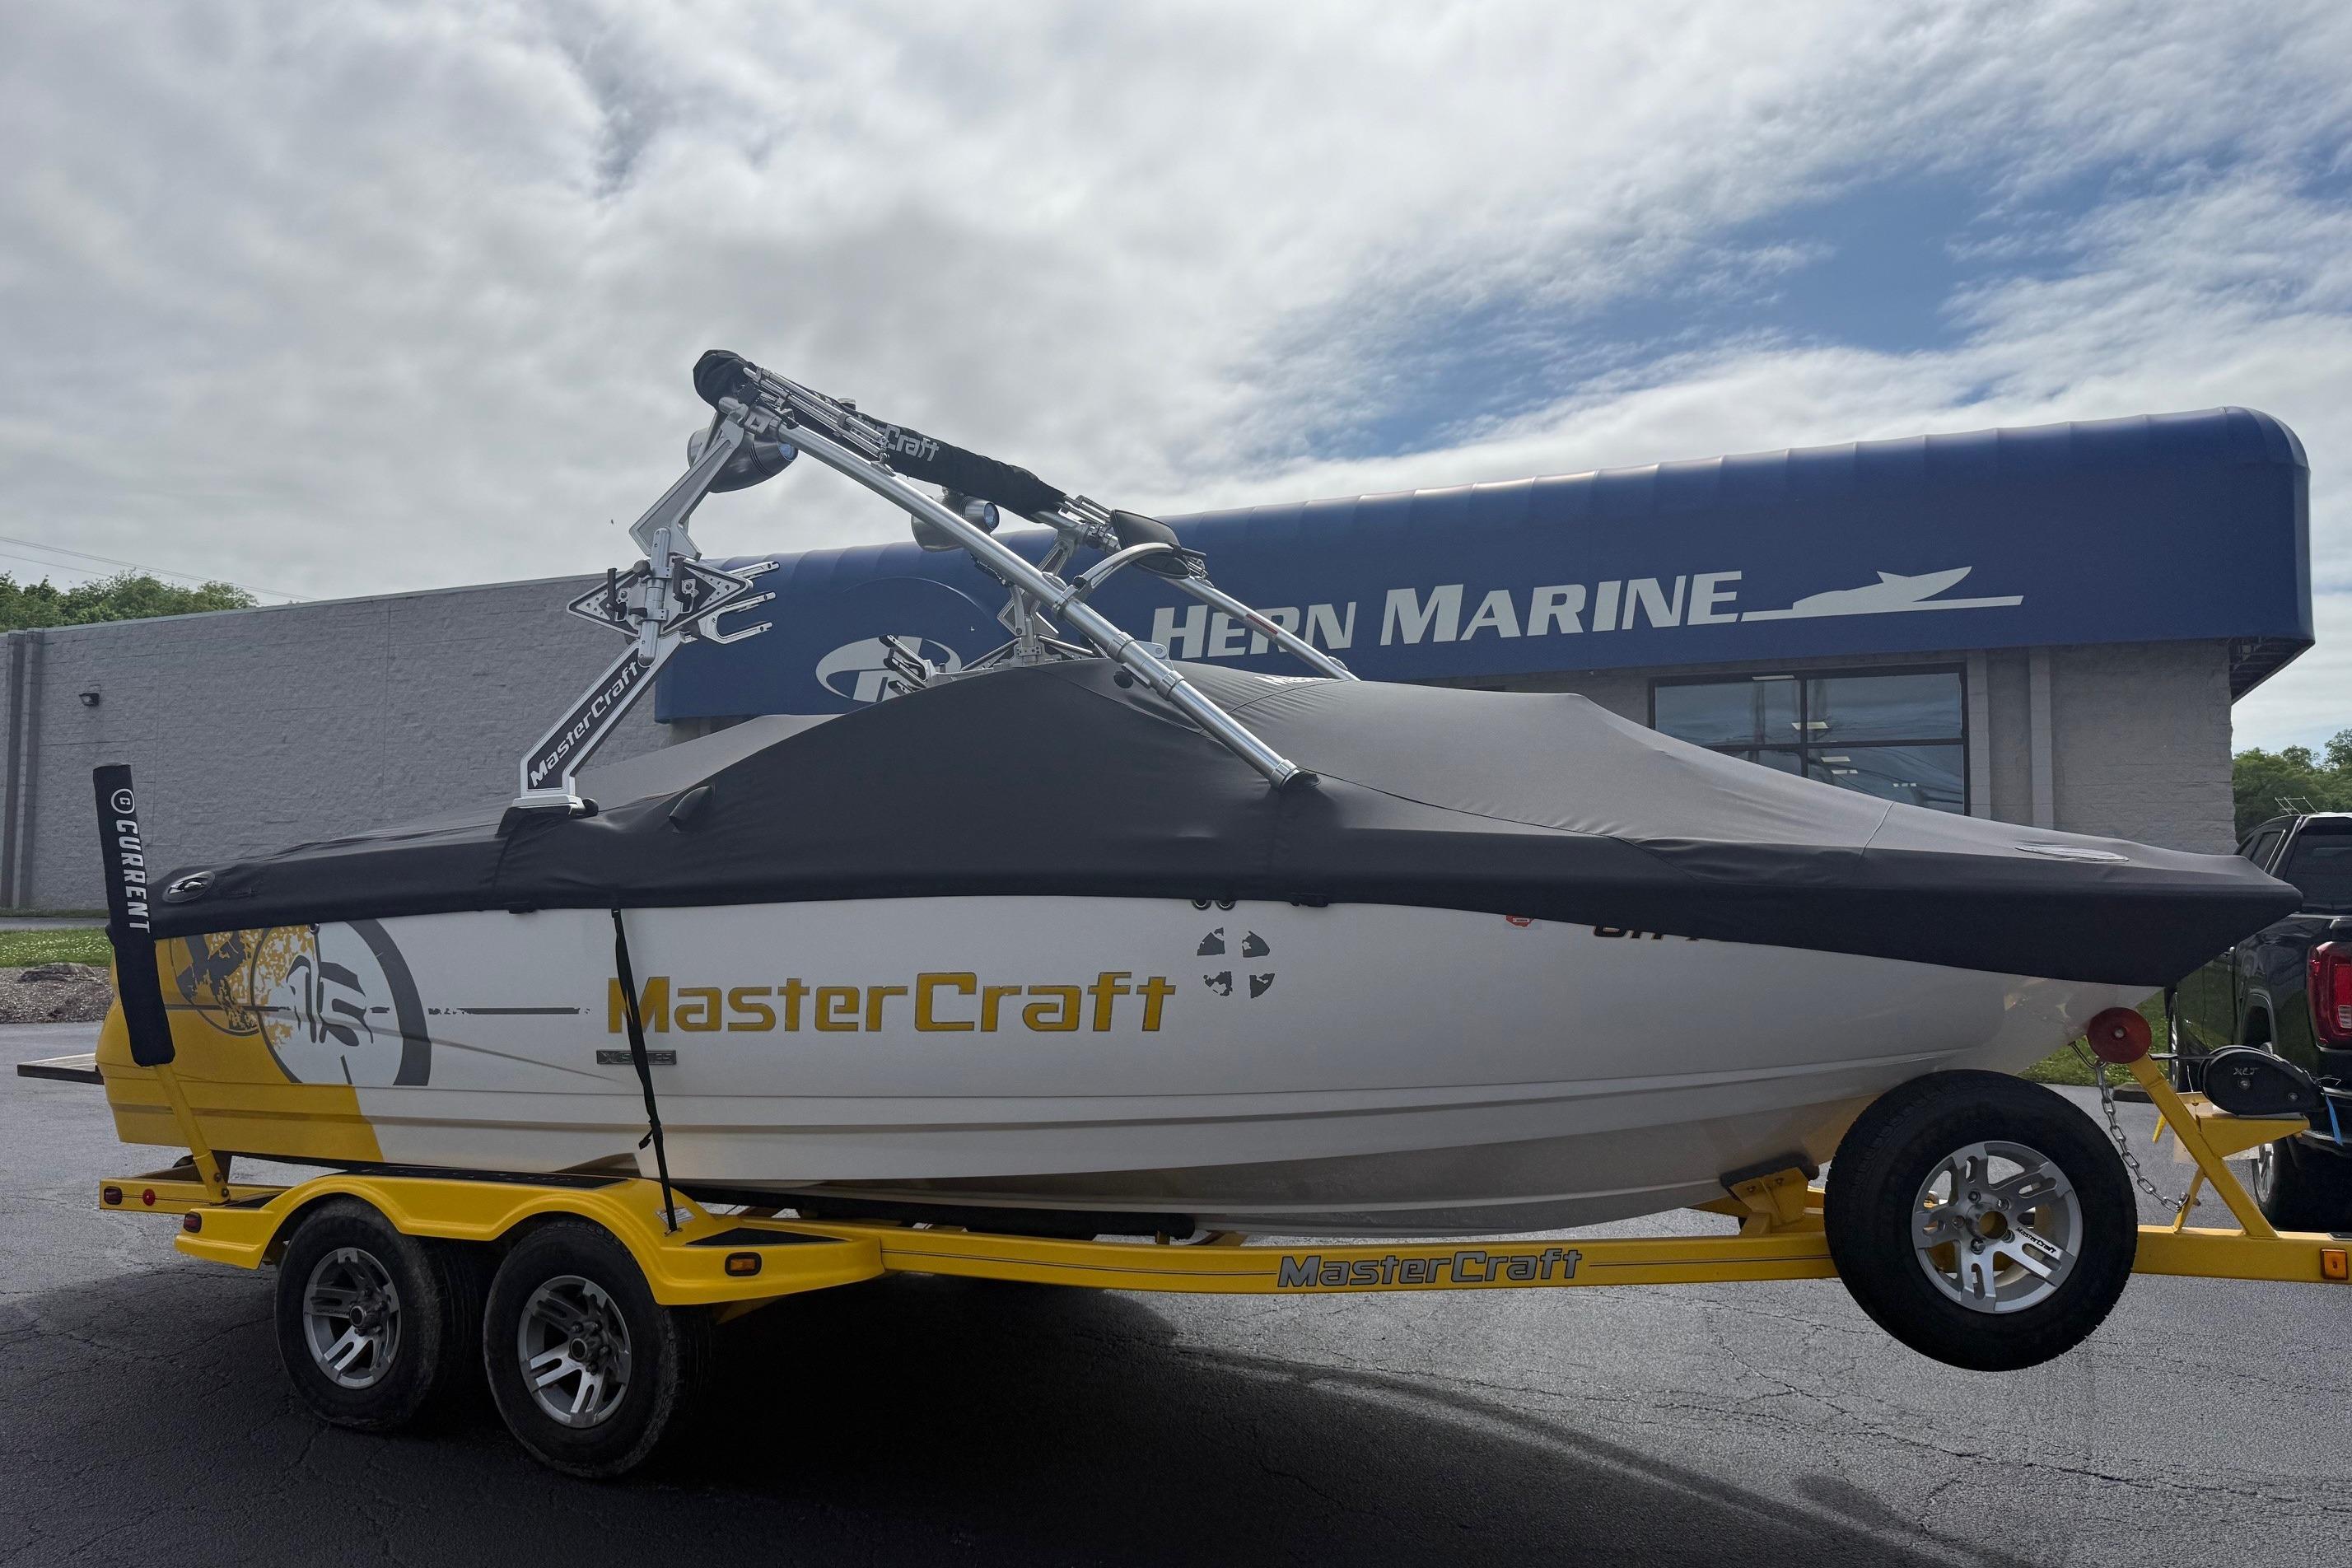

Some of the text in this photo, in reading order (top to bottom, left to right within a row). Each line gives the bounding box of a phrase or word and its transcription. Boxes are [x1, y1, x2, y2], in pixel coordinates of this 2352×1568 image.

[1151, 571, 1743, 659] HERN MARINE
[530, 661, 638, 787] MasterCraft
[116, 819, 151, 934] CURRENT
[608, 972, 1176, 1034] MasterCraft
[1277, 1248, 1582, 1288] MasterCraft
[2015, 1227, 2057, 1253] MasterCraft
